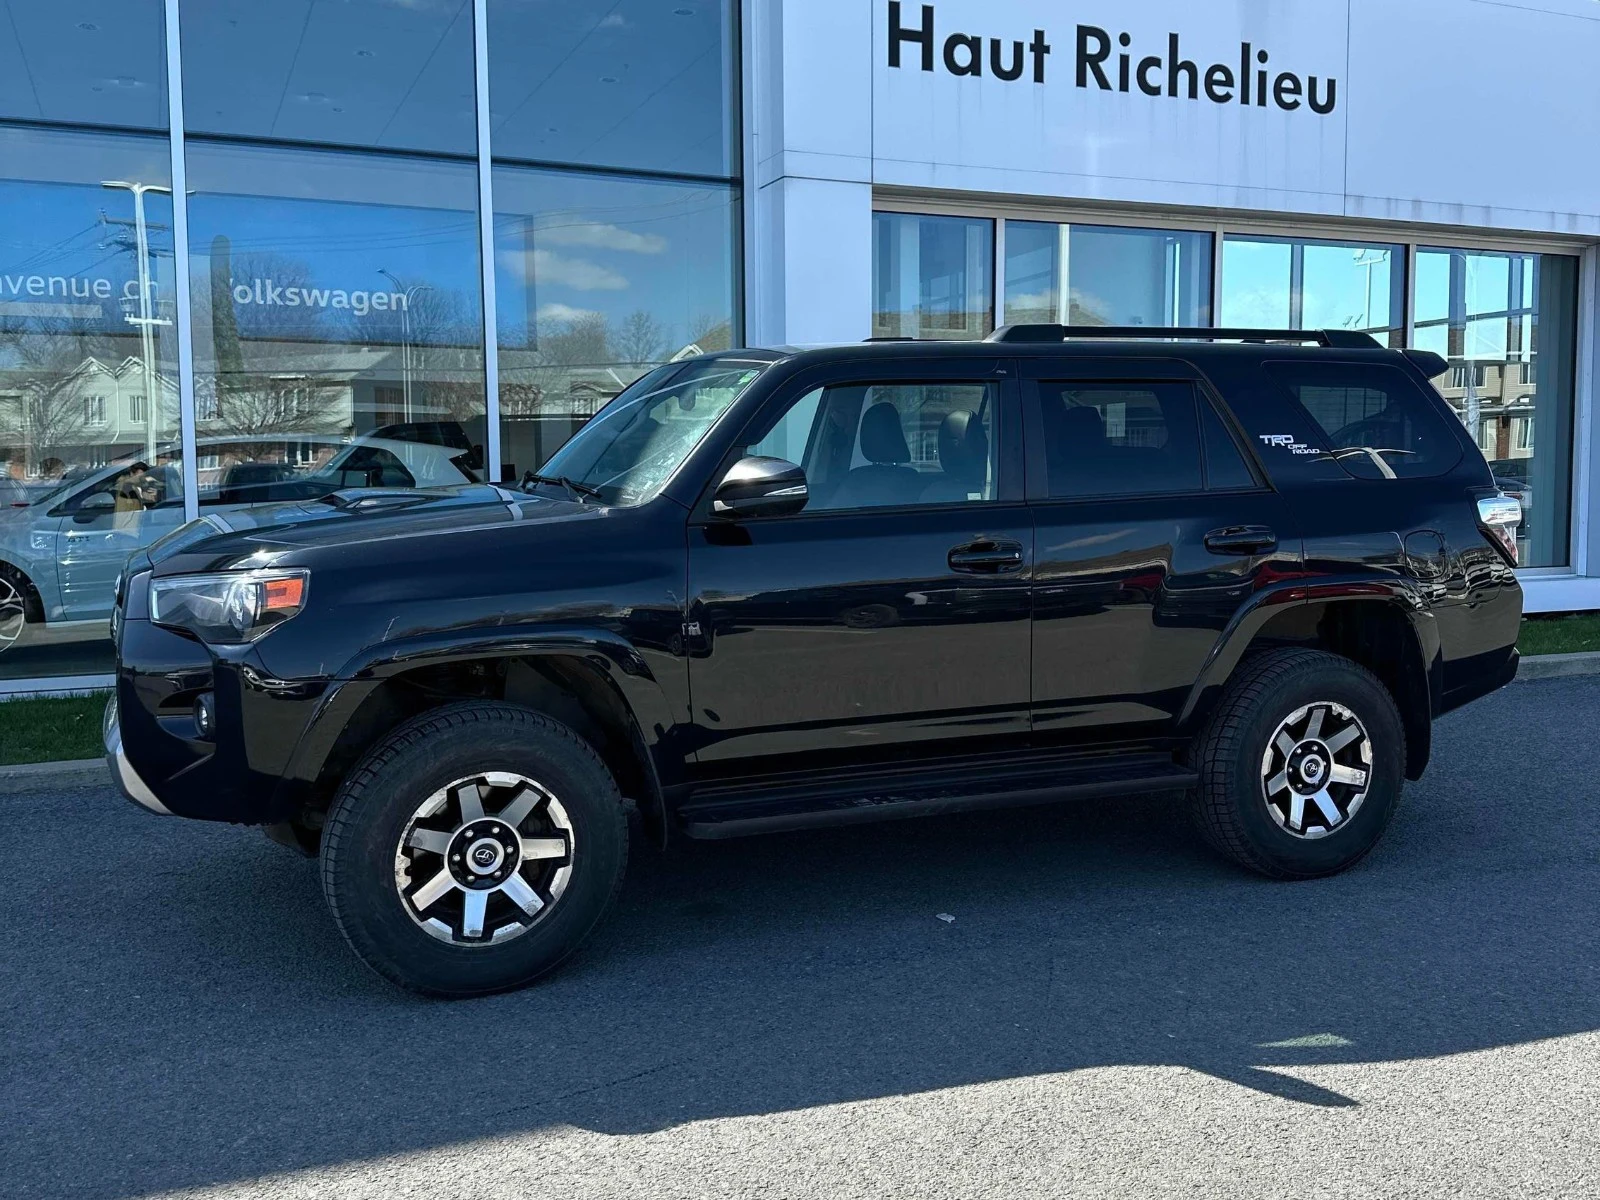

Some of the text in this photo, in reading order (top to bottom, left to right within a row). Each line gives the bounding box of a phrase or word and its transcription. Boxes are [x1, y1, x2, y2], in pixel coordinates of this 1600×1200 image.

[888, 0, 1337, 115] Haut Richelieu
[0, 275, 112, 299] venue
[230, 278, 408, 316] olkswagen
[1259, 434, 1294, 447] TRD
